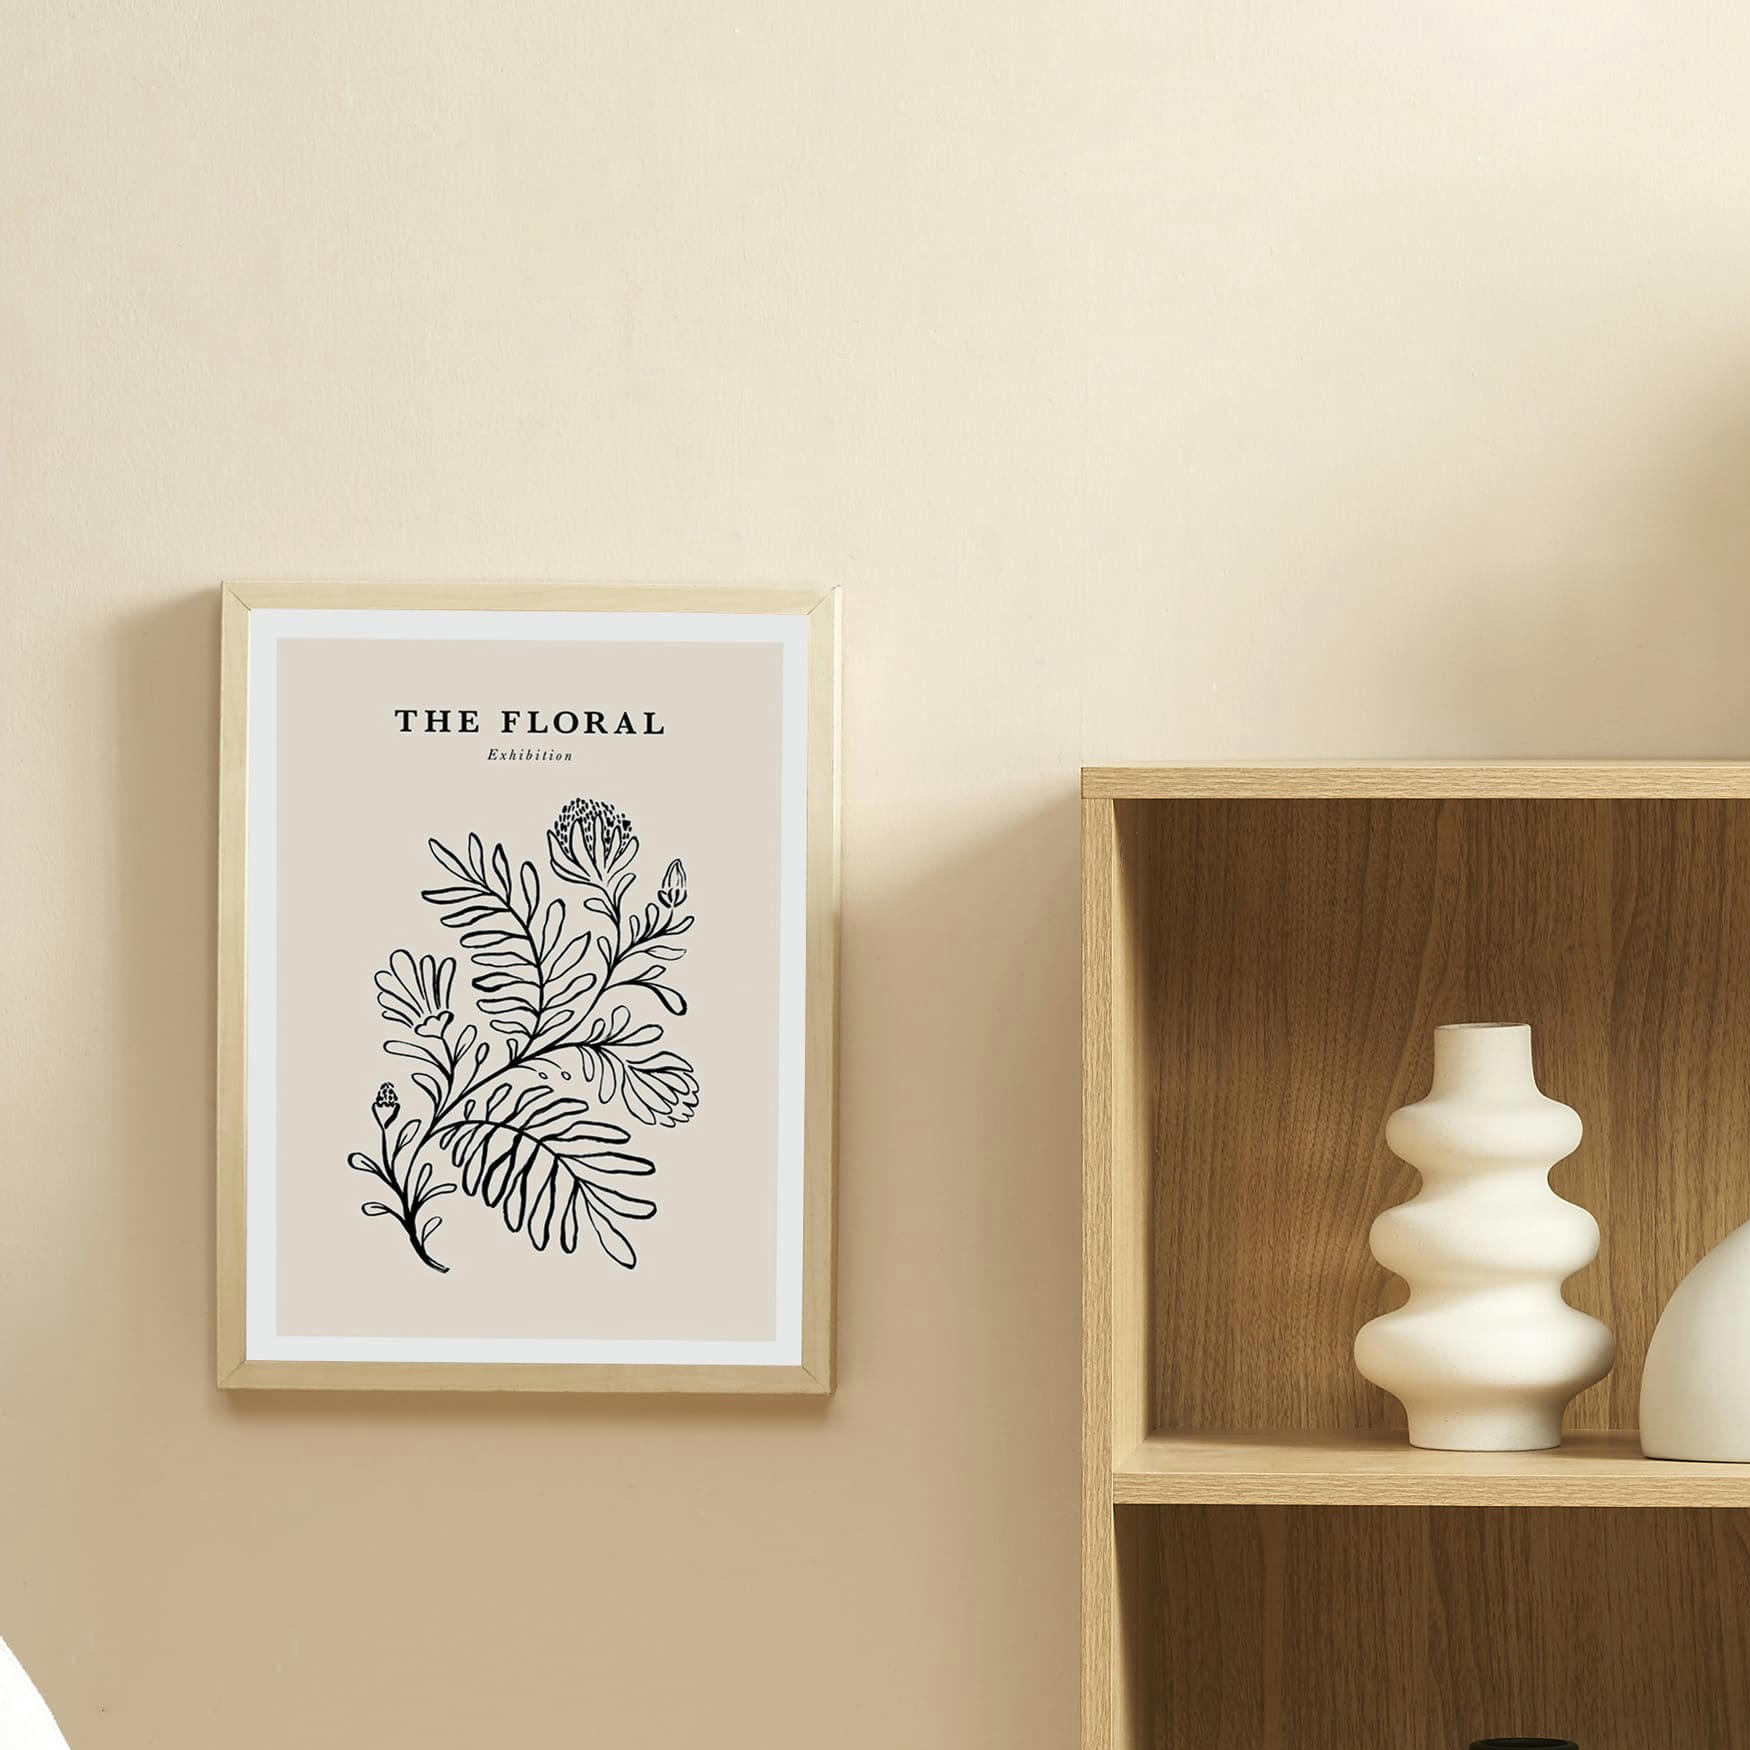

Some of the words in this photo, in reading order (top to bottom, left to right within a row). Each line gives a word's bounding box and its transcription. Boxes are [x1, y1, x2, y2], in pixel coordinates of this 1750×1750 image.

[394, 709, 480, 733] THE
[500, 710, 665, 735] FLORAL
[487, 748, 573, 761] Exhibition
